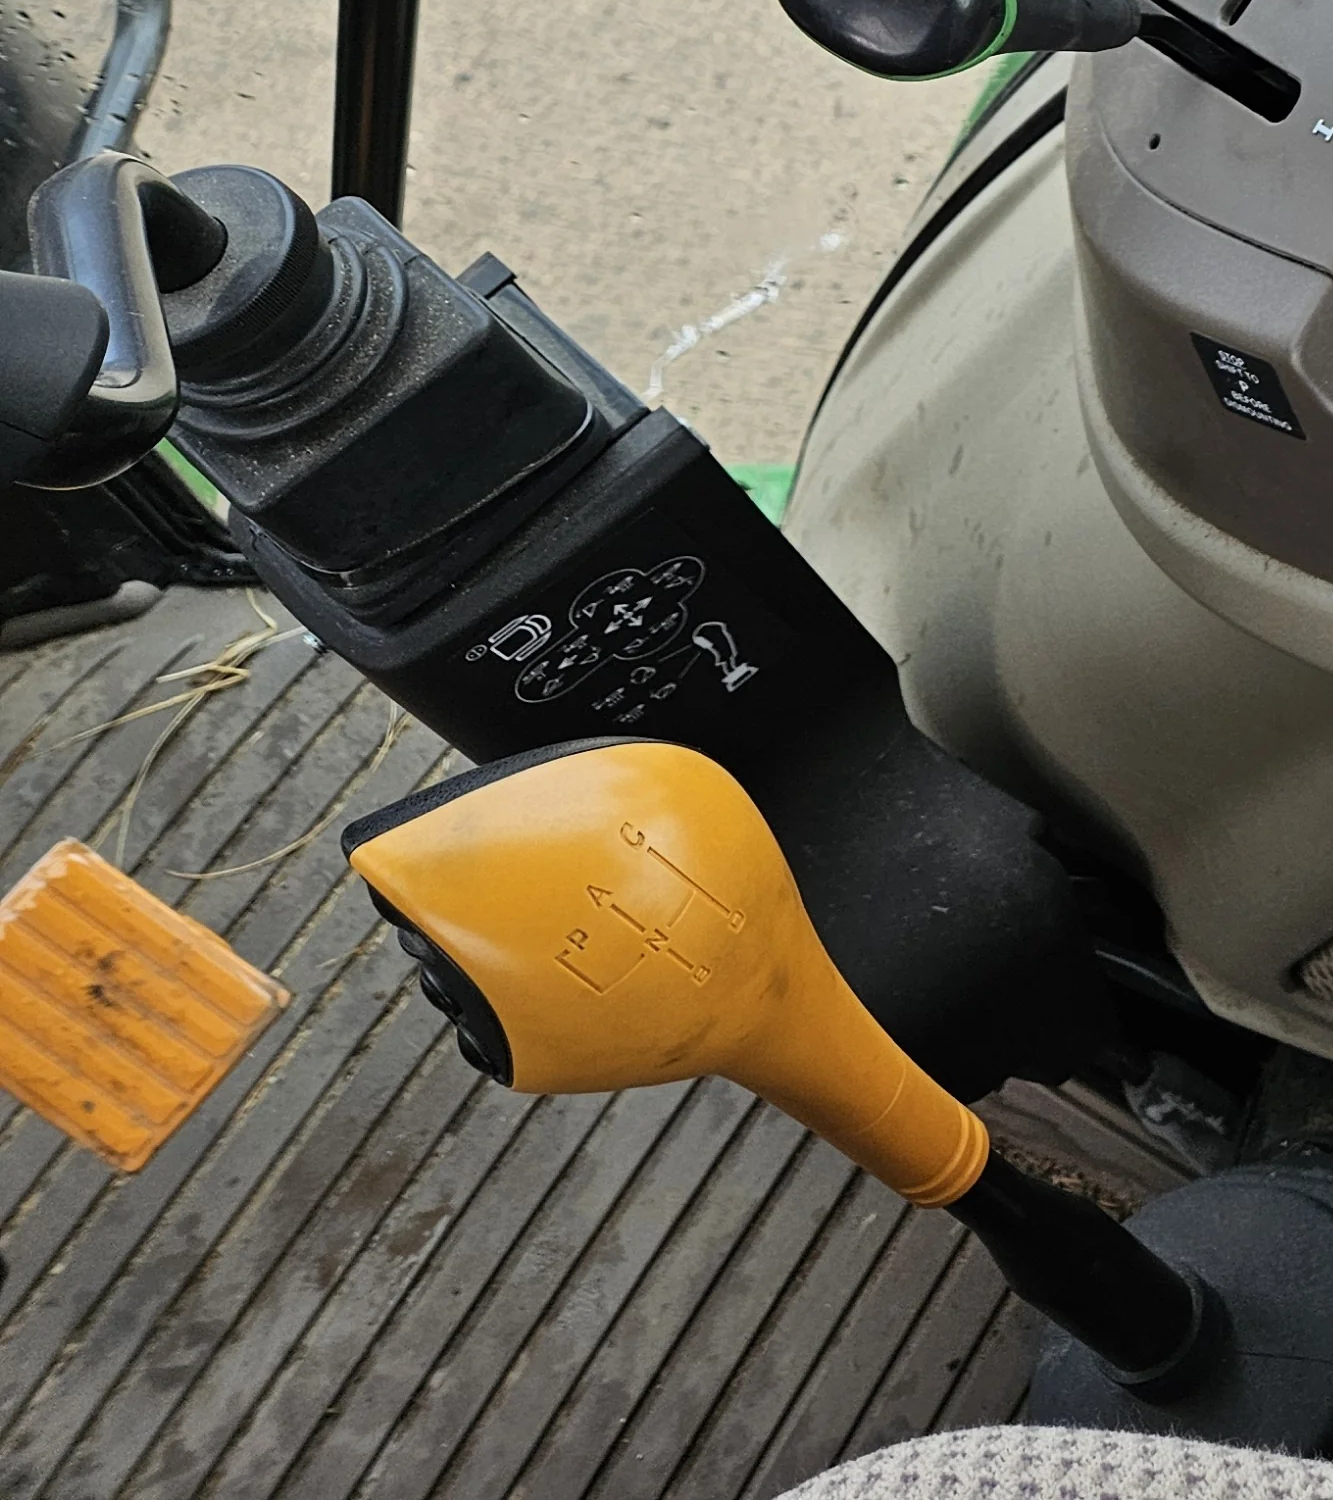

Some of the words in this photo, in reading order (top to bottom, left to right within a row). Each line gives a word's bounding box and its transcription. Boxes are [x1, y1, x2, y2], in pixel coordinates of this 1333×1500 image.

[586, 885, 613, 907] A
[566, 928, 589, 951] P
[645, 928, 669, 952] N
